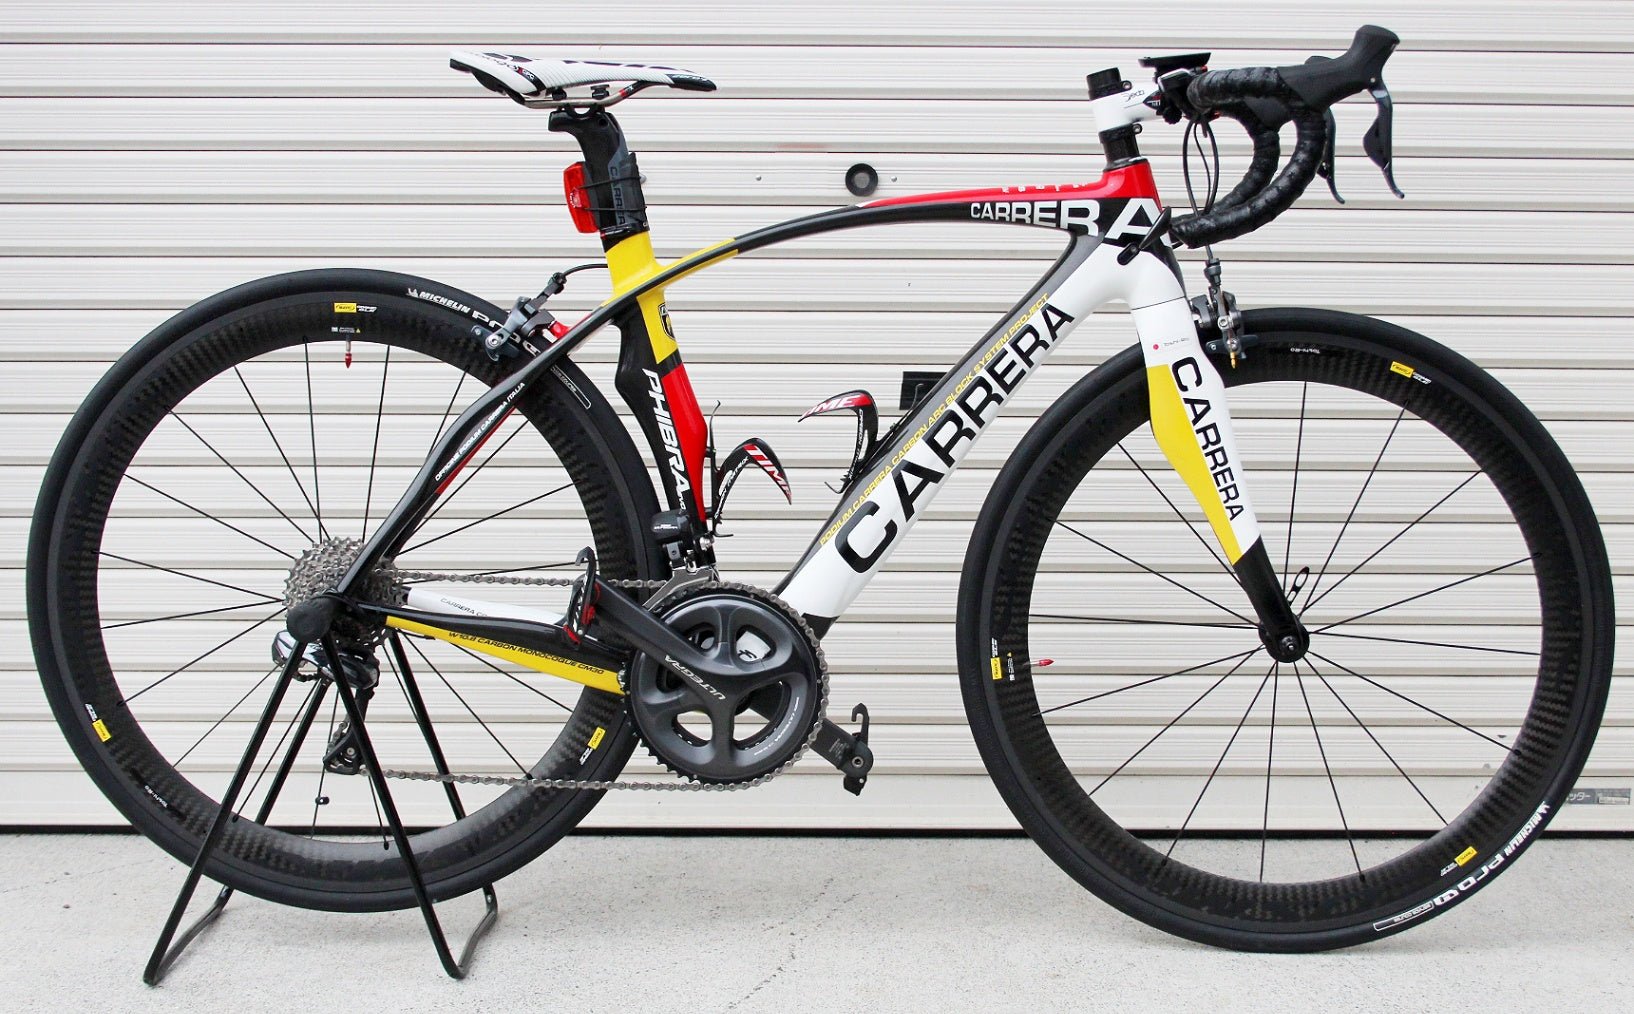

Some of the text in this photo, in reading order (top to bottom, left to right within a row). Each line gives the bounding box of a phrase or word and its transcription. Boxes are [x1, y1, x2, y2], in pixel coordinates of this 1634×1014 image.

[971, 197, 1174, 247] CARRERA
[419, 291, 471, 314] MICHELIN
[481, 400, 508, 431] CARRERA
[506, 382, 526, 402] ITALIA
[642, 368, 690, 493] PHIBRA
[819, 292, 1050, 545] PODIUM CARRERA CARBON ARC BLOCK SYSTEM PROJECT
[834, 303, 1075, 574] CARRERA
[1171, 356, 1245, 521] CARRERA
[477, 637, 516, 651] CARBON
[517, 646, 578, 667] MONOCOQUE
[578, 663, 605, 675] CM30
[664, 654, 726, 700] ULTEGRA
[1503, 814, 1543, 856] MICHELIN
